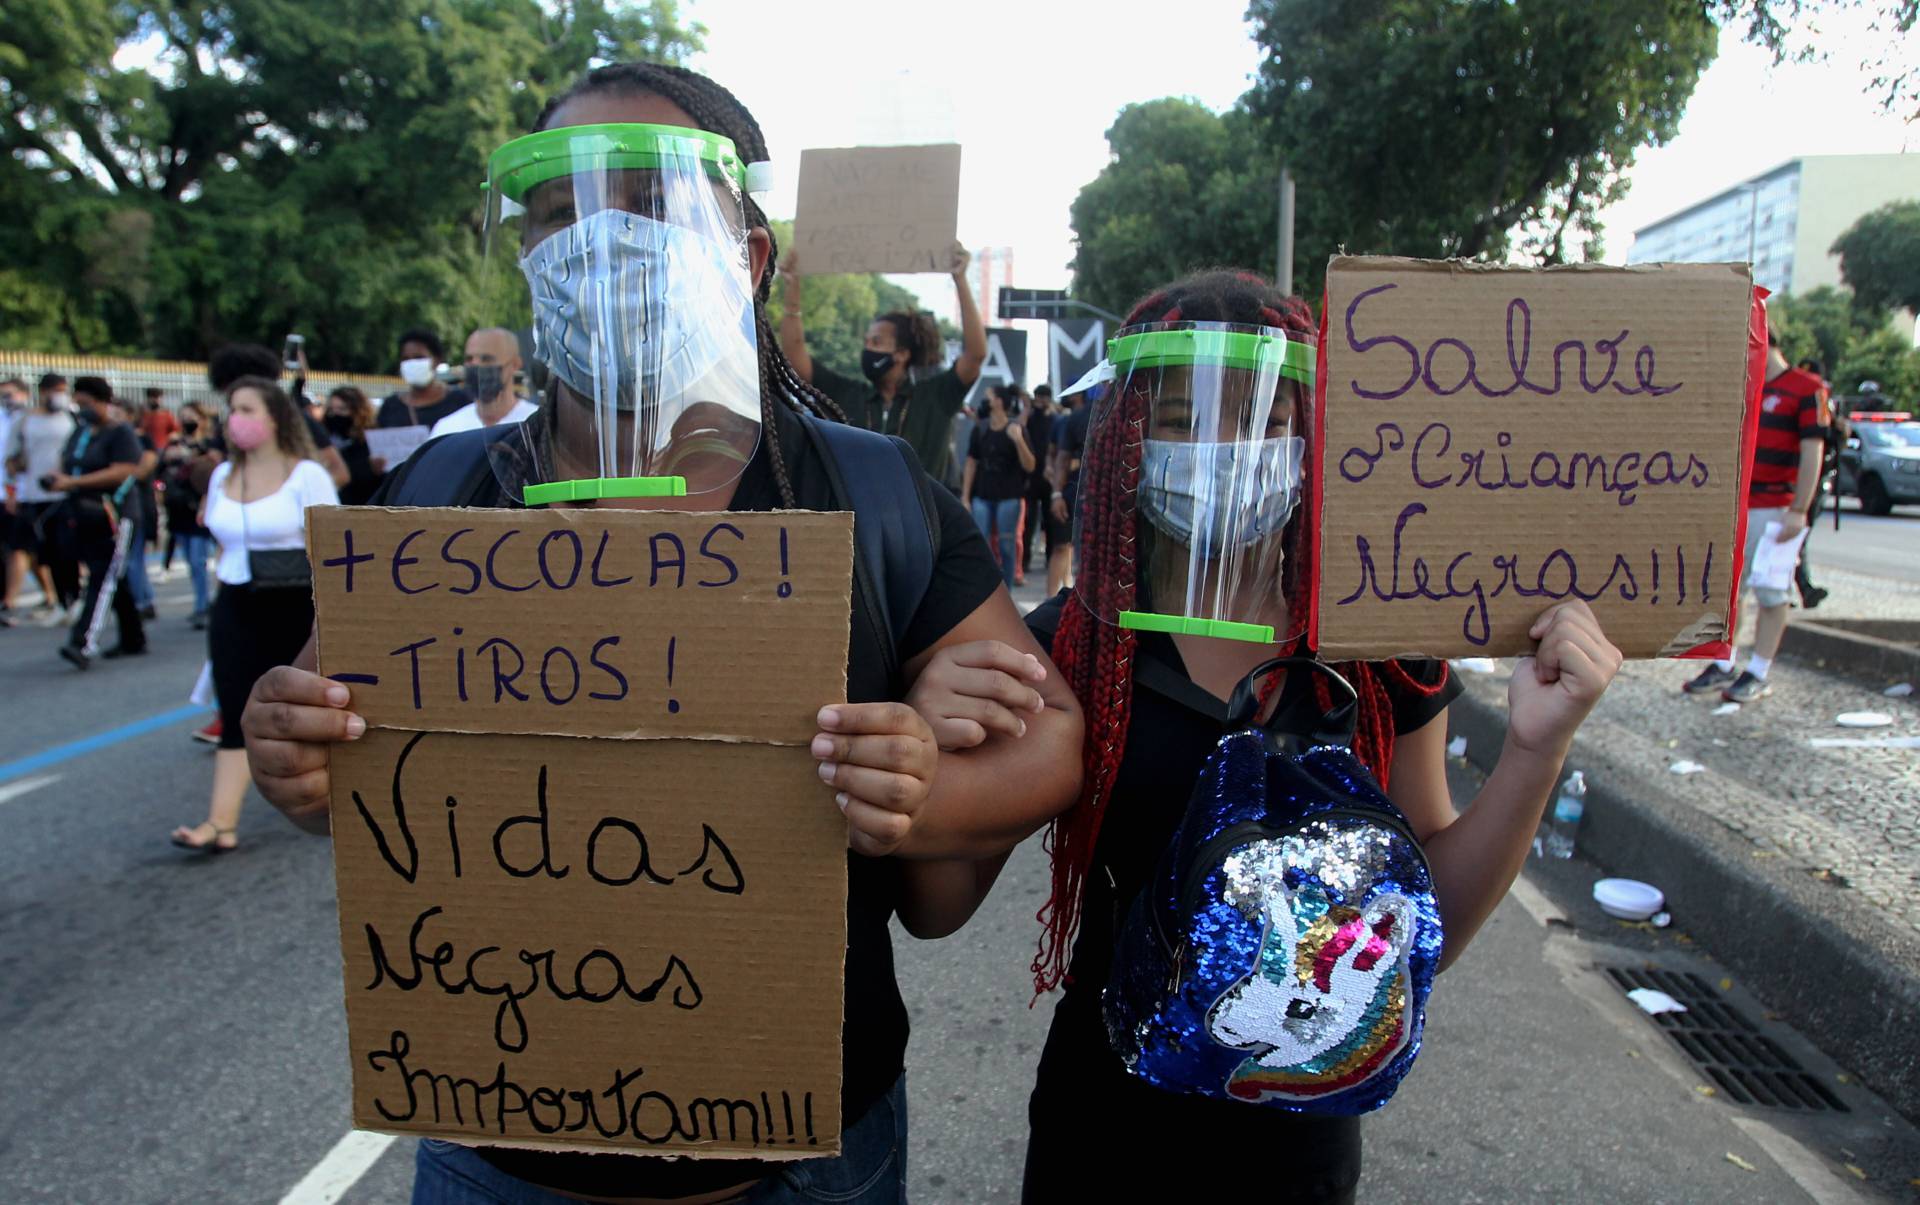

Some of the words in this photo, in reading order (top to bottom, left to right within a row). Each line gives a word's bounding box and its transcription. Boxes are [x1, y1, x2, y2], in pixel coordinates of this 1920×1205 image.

[1345, 284, 1683, 399] Salve
[1411, 423, 1708, 505] Crianças
[1337, 502, 1713, 646] Negras!!!
[352, 732, 745, 895] Vidas
[365, 906, 703, 1053] Negras
[368, 1031, 818, 1148] Importam!!!
